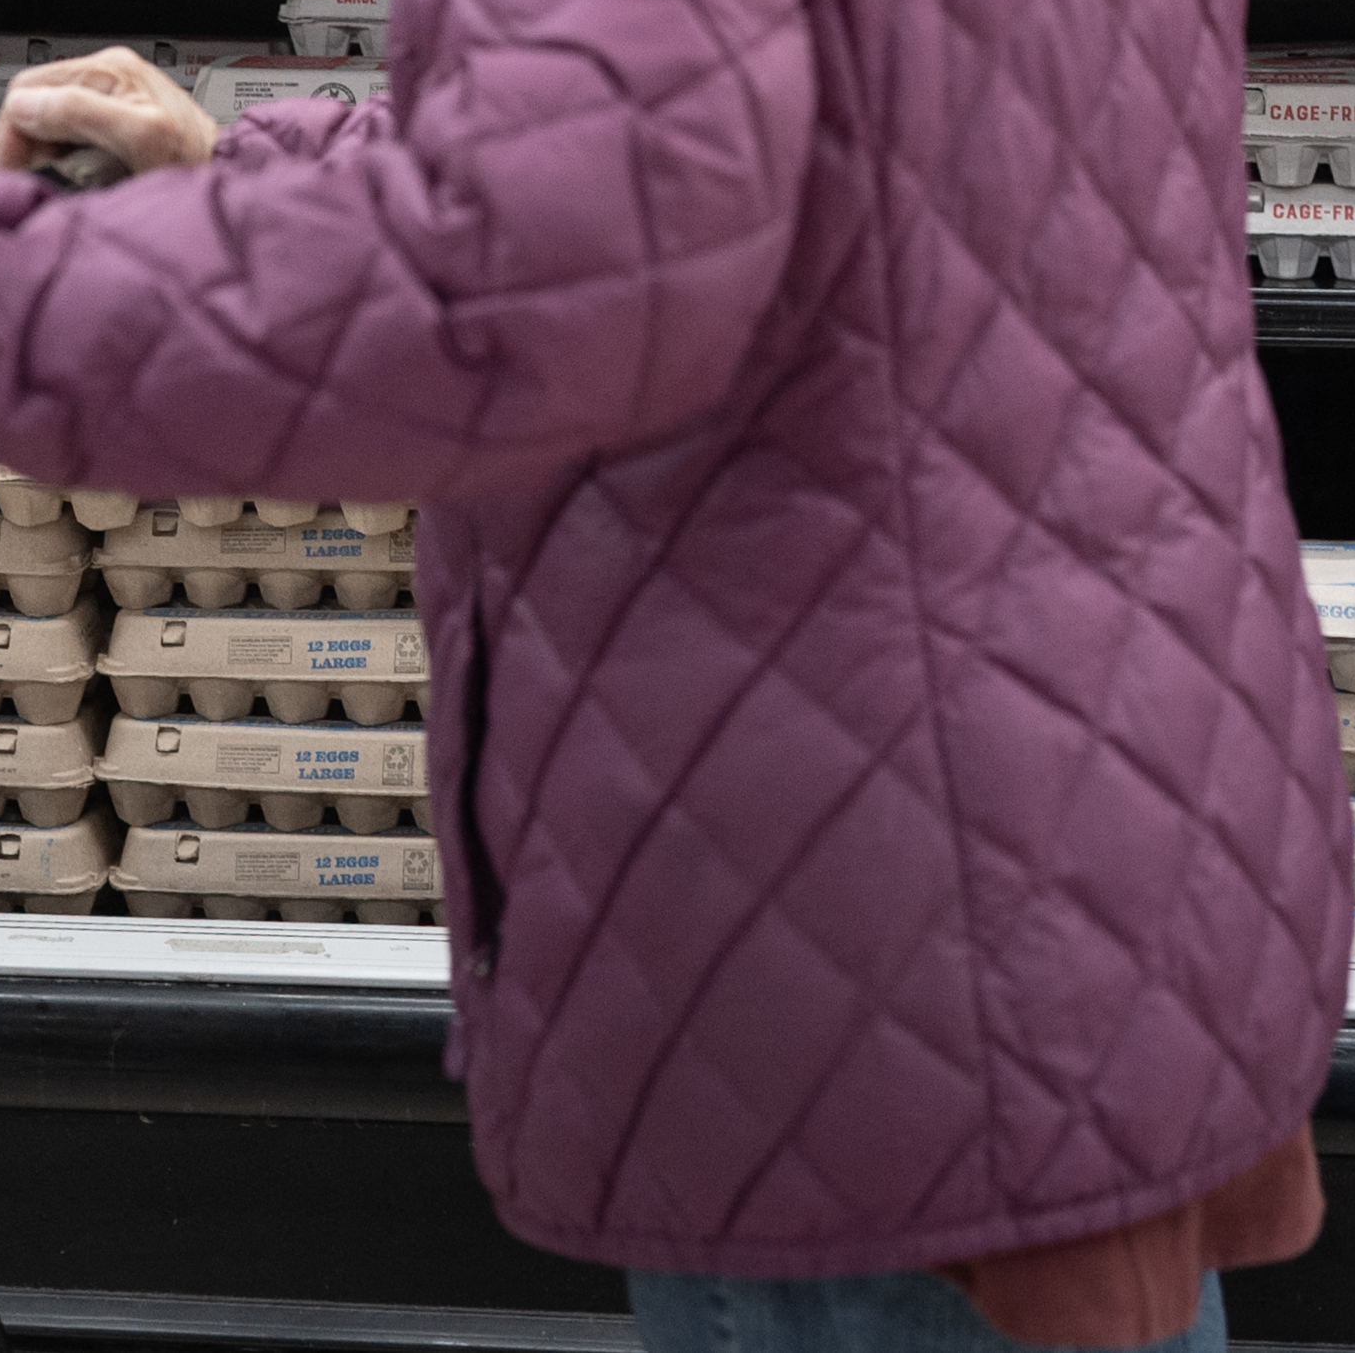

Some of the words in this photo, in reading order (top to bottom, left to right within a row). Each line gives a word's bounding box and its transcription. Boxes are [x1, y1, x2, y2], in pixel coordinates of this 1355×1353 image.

[307, 640, 324, 653] 12
[327, 640, 371, 652] EGGS
[311, 657, 367, 669] LARGE
[315, 857, 331, 869] 12
[335, 856, 379, 869] EGGS
[318, 874, 375, 886] LARGE
